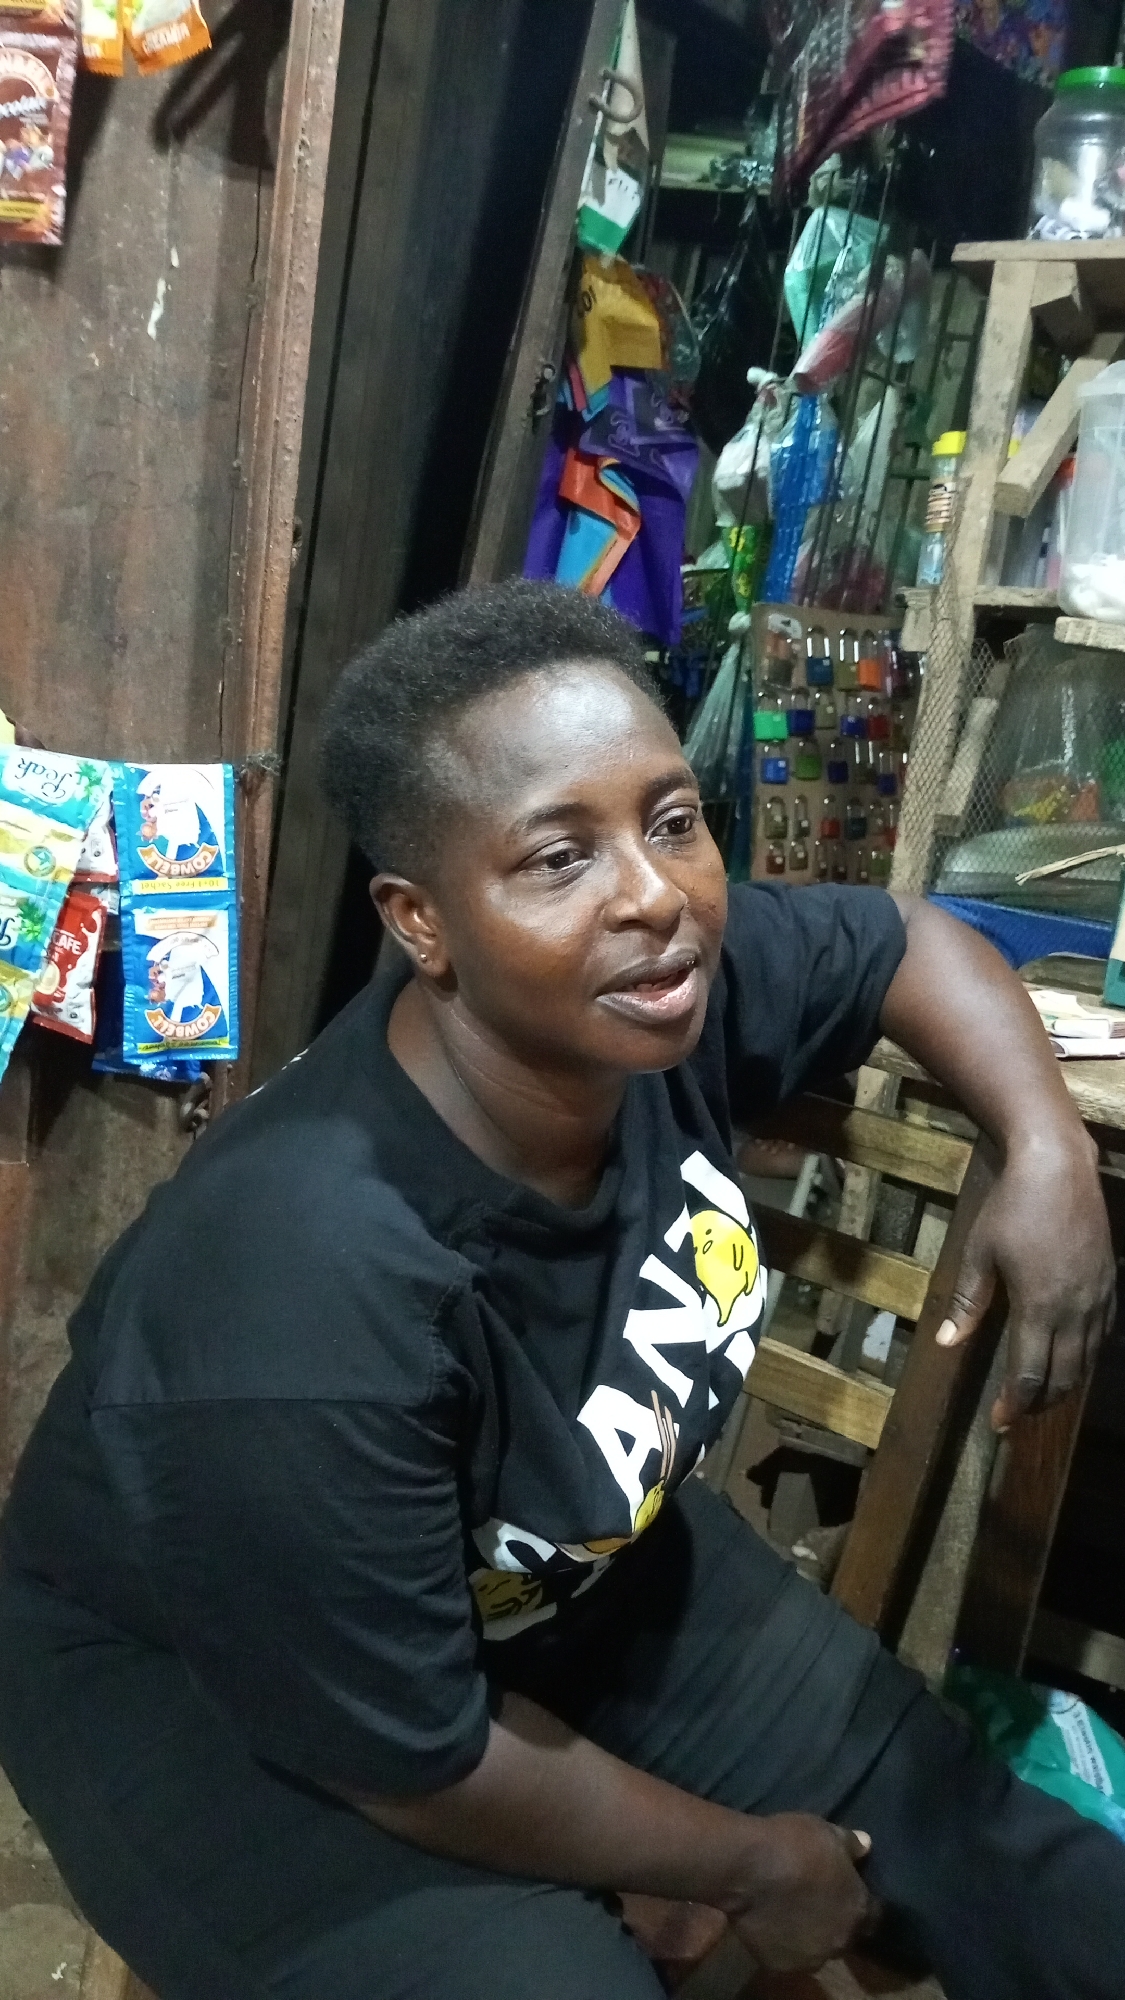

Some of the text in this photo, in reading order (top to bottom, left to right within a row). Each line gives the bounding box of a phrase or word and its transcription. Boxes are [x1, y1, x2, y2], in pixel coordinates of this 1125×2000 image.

[15, 758, 73, 799] Peak
[147, 851, 213, 877] COWBELL
[141, 881, 172, 890] Sachet
[175, 880, 195, 888] Free
[53, 933, 82, 955] CAFE
[151, 1010, 216, 1038] COWBELL
